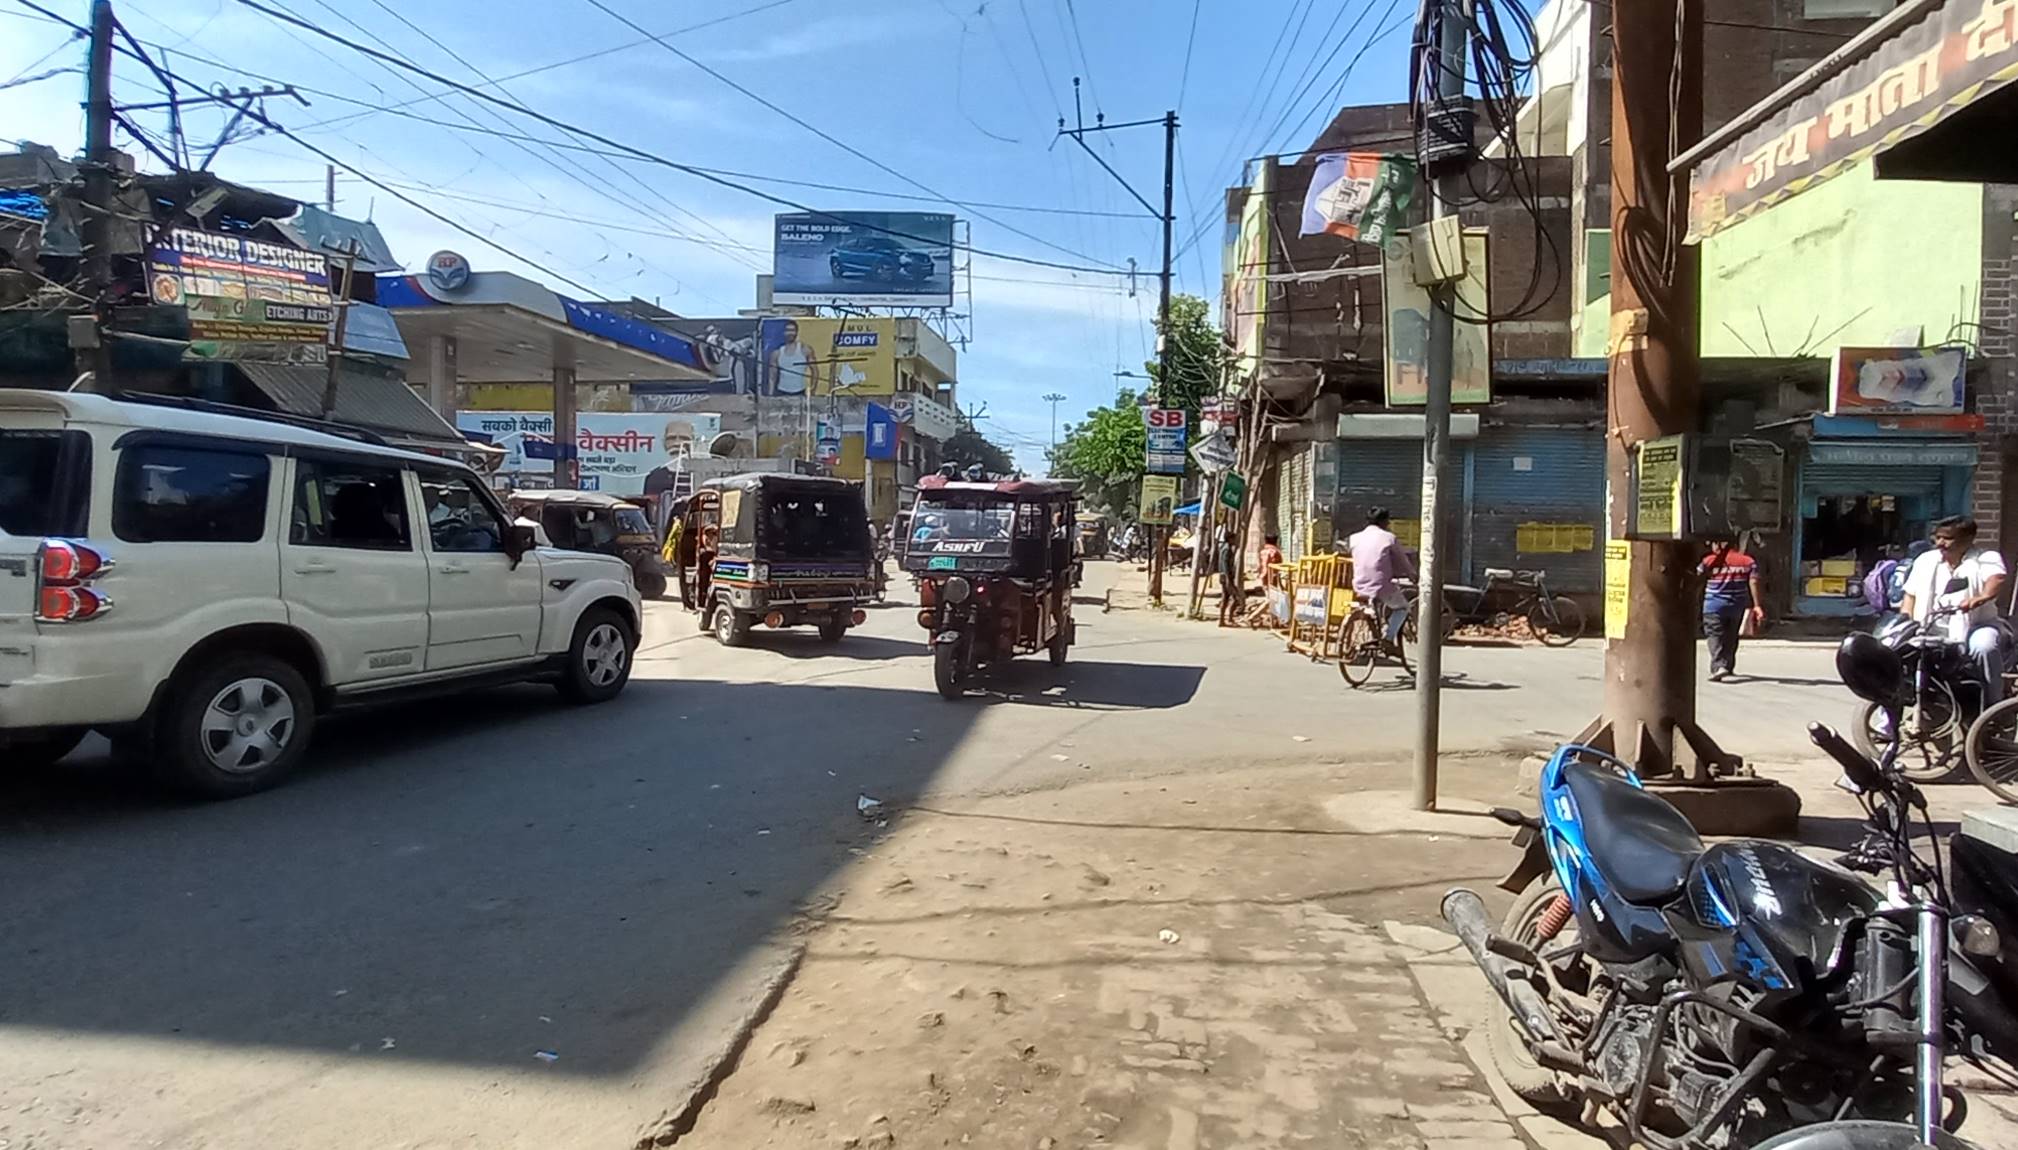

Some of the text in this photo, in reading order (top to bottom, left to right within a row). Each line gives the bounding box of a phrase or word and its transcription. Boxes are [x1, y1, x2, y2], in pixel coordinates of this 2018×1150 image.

[1742, 116, 1817, 190] जय
[1824, 44, 1943, 139] माता
[781, 224, 795, 233] GET
[796, 225, 810, 233] THE
[811, 225, 830, 233] BOLD
[781, 234, 825, 242] BALENO
[244, 240, 328, 277] DESIGNER
[437, 256, 457, 269] HP
[835, 335, 876, 345] COMFY
[894, 401, 909, 411] HP
[1149, 410, 1184, 428] SB
[576, 427, 656, 453] वैक्सीन
